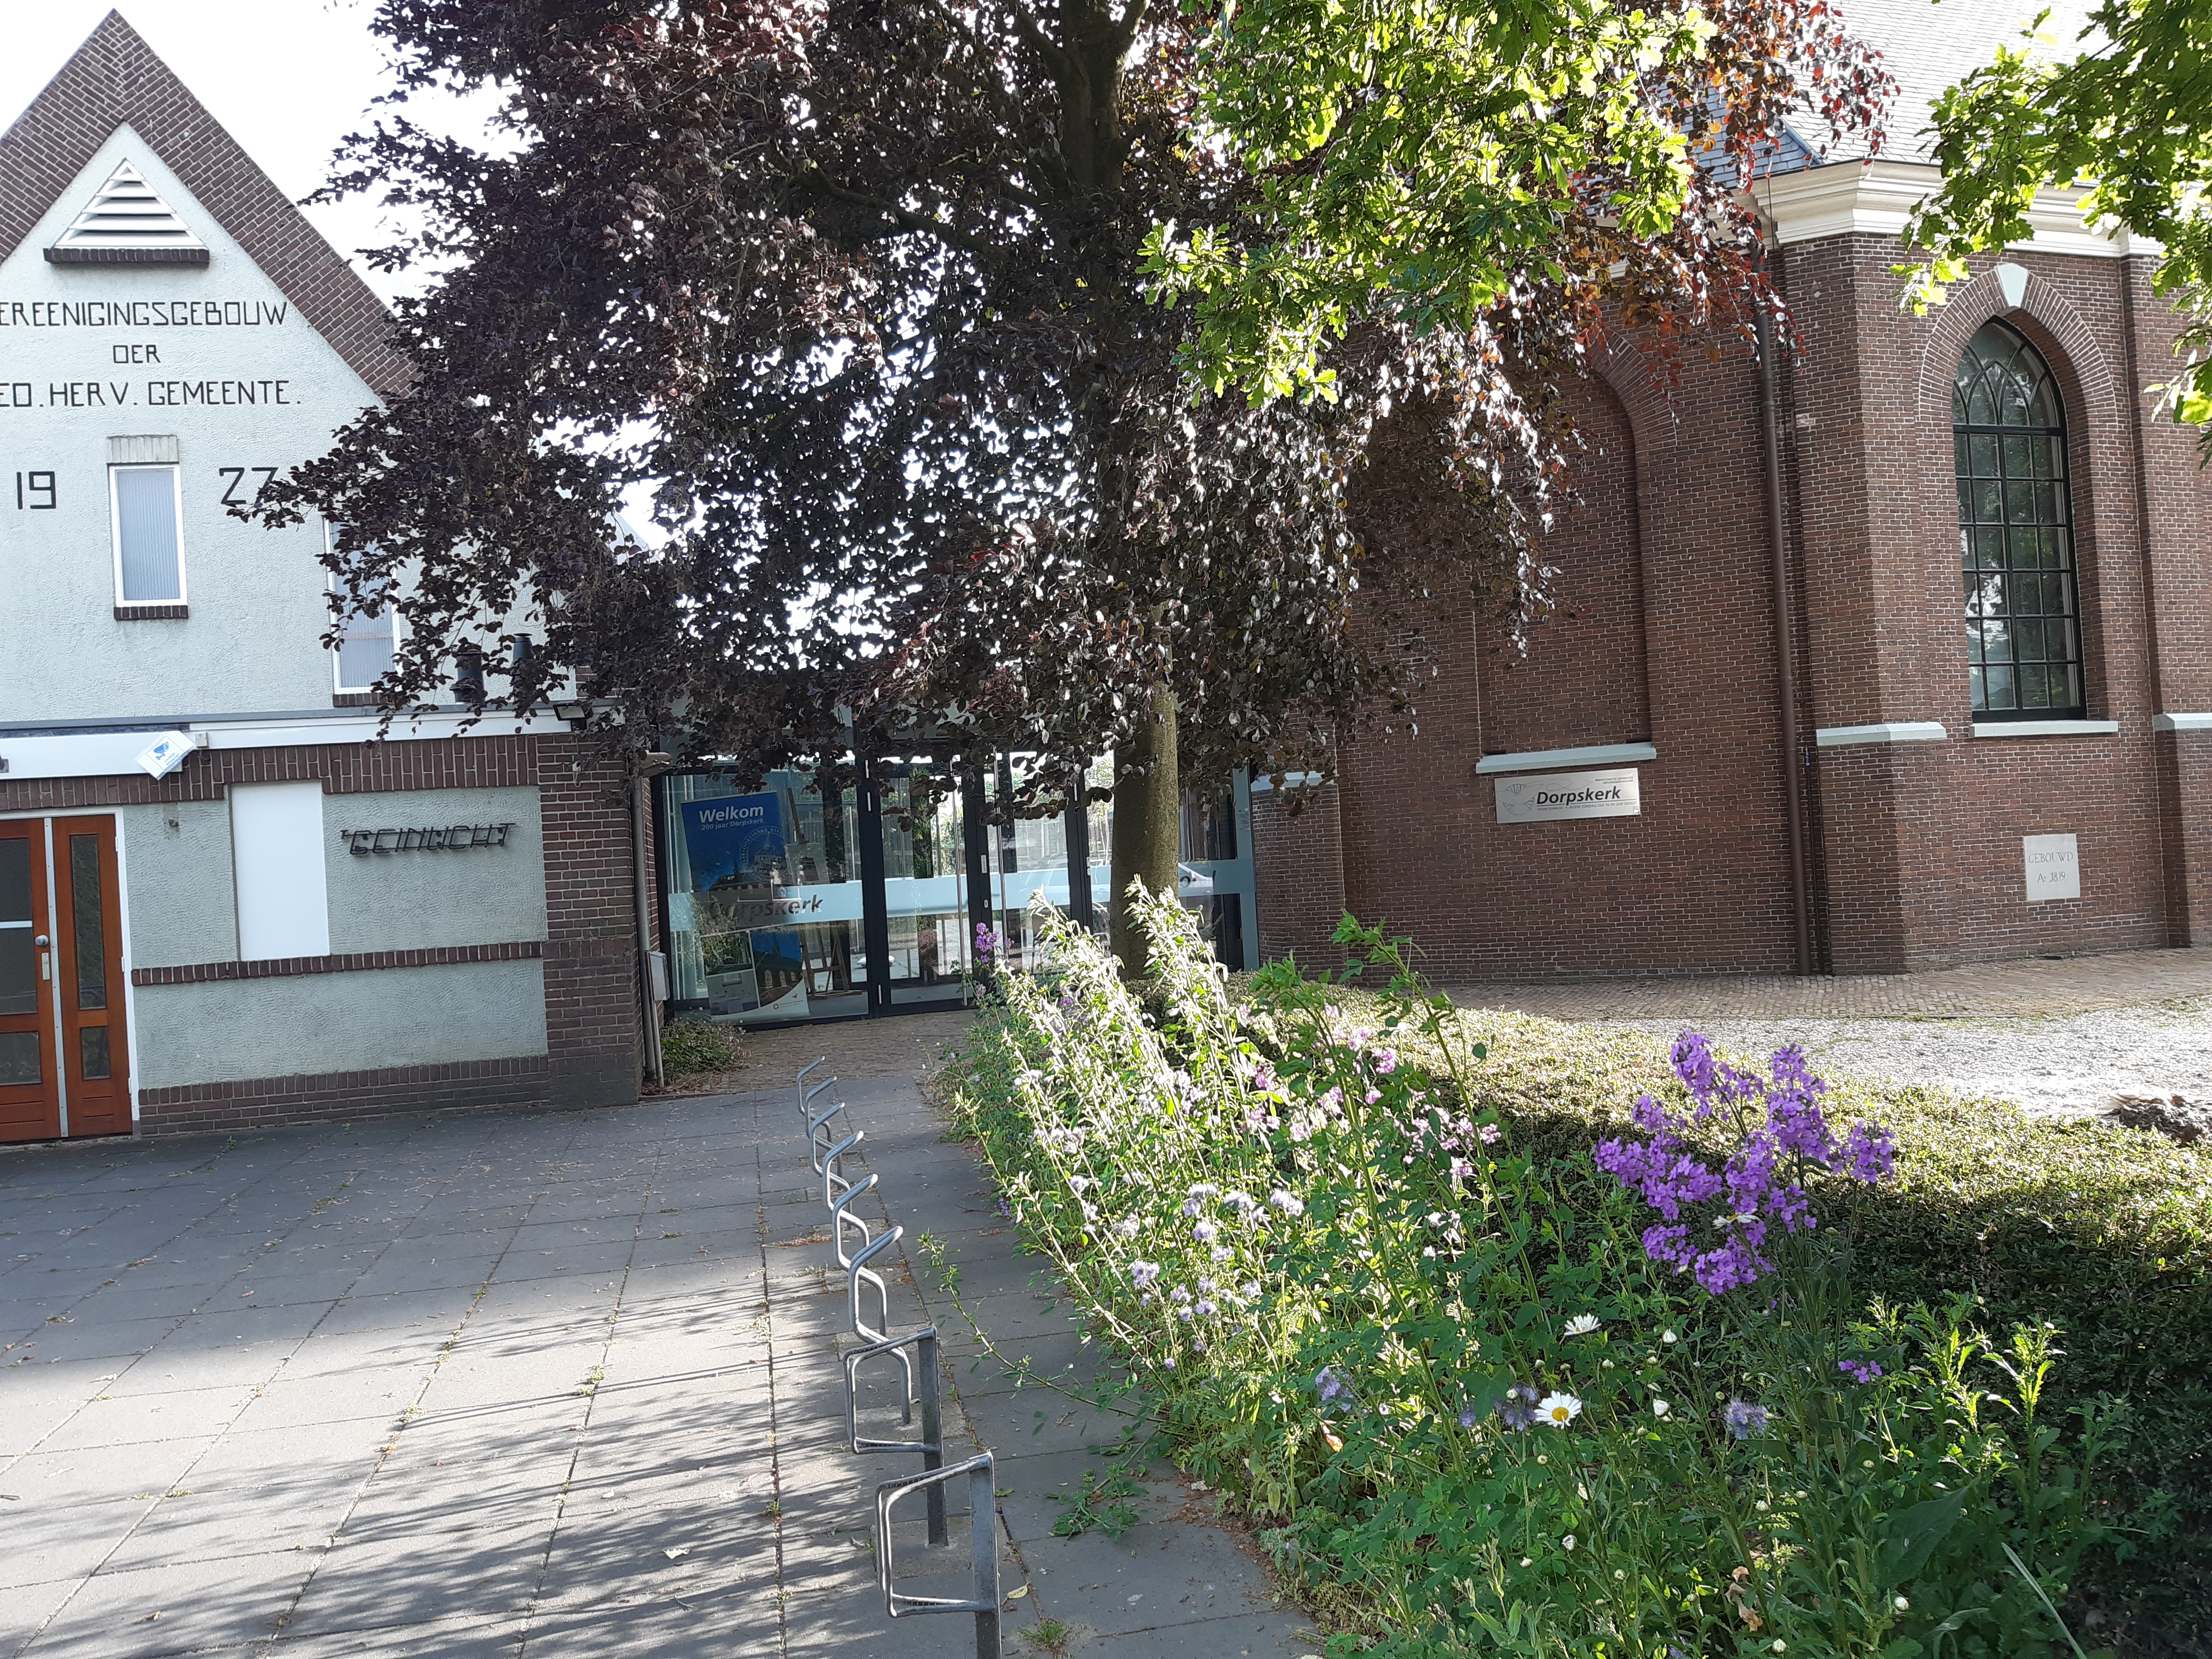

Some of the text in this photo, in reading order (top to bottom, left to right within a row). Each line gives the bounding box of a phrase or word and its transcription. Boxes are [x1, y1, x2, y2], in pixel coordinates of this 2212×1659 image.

[0, 301, 287, 326] EREENIGINGSGEBOUW
[113, 345, 161, 363] DER
[0, 380, 301, 407] ED. HERV. GEMEENTE.
[16, 471, 56, 510] 19
[1537, 785, 1622, 806] Dorpskerk
[699, 805, 764, 823] Welkom
[715, 822, 729, 830] jaar
[730, 817, 764, 827] Dorpskerk
[2028, 851, 2074, 864] GEBOUWD
